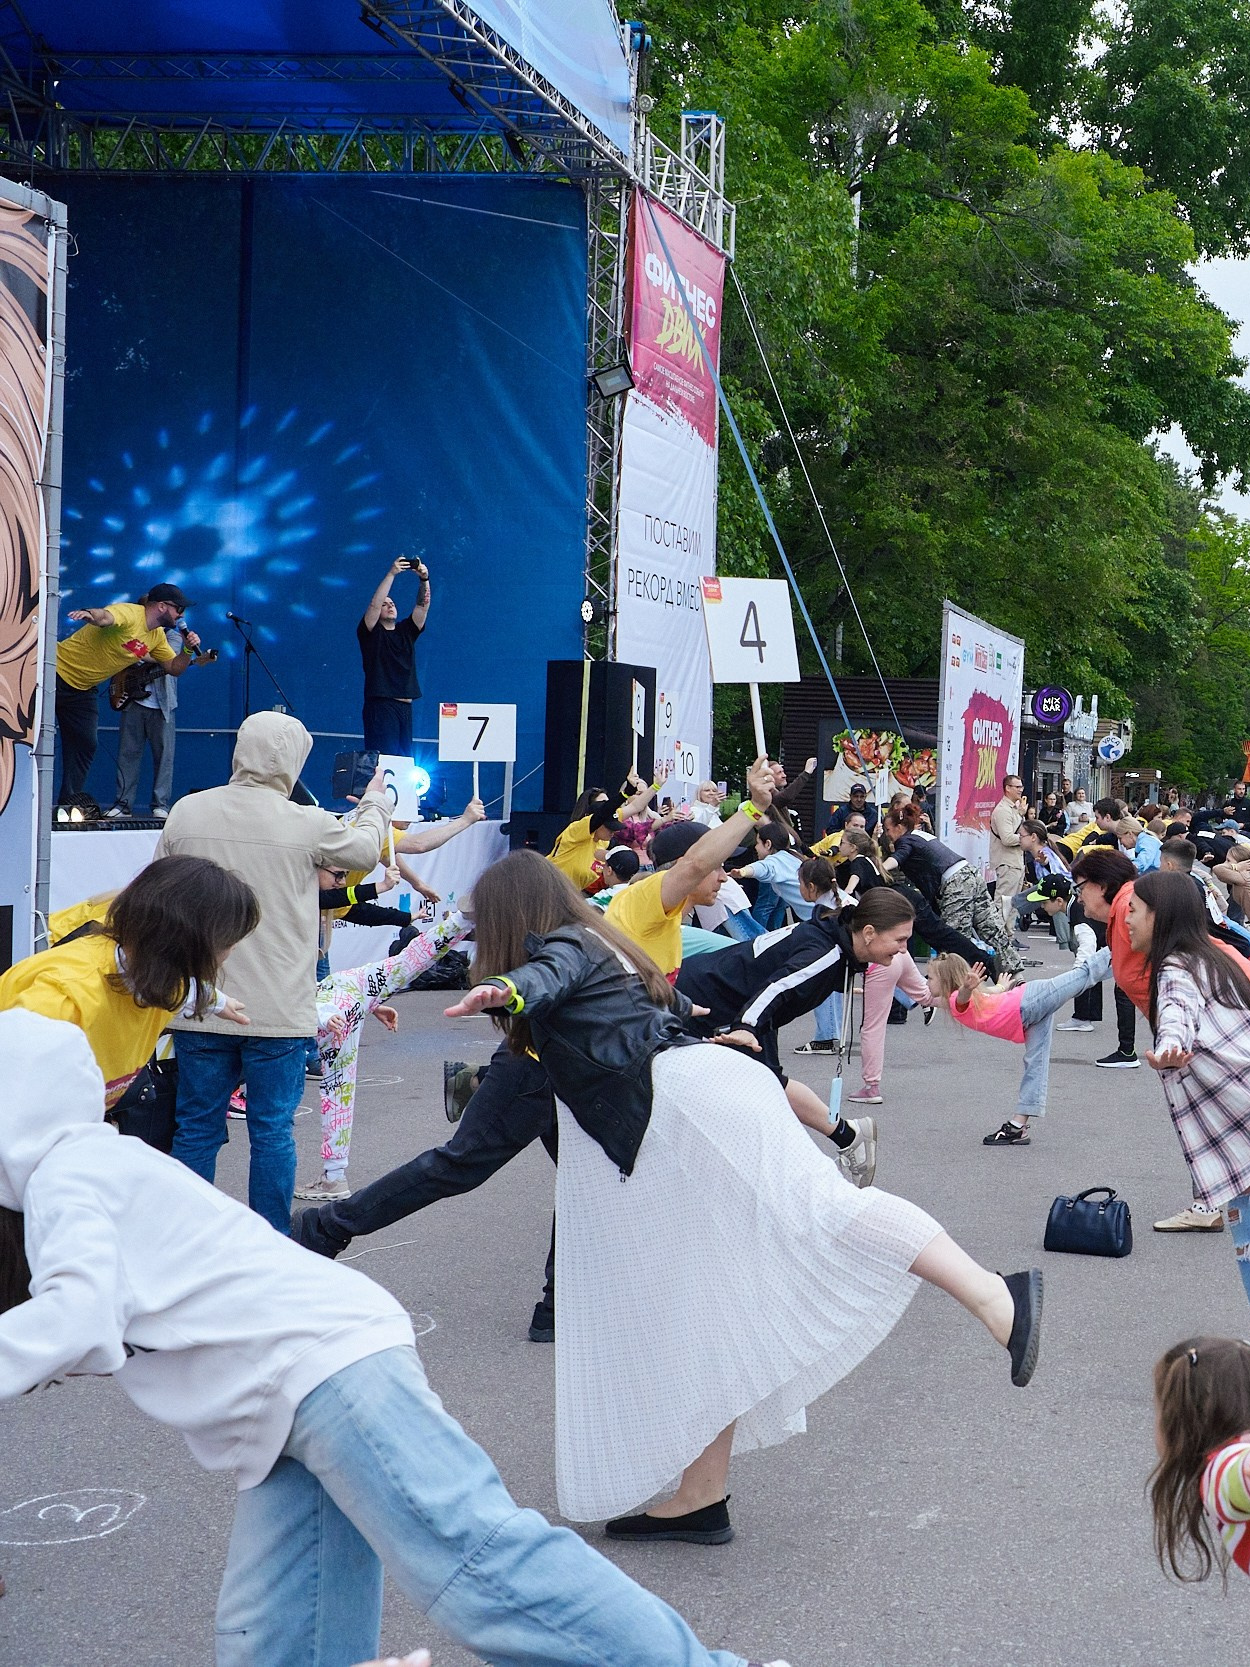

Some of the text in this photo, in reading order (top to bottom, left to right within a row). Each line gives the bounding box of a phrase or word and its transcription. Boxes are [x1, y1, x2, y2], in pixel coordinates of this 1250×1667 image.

[644, 514, 701, 556] ПОСТАВИМ
[628, 568, 701, 612] РЕКОРД ВМЕС
[739, 600, 767, 664] 4
[665, 701, 673, 729] 9
[1043, 704, 1061, 712] BAR
[467, 716, 490, 751] 7
[972, 717, 1003, 748] ФИТНЕС
[680, 750, 695, 777] 10
